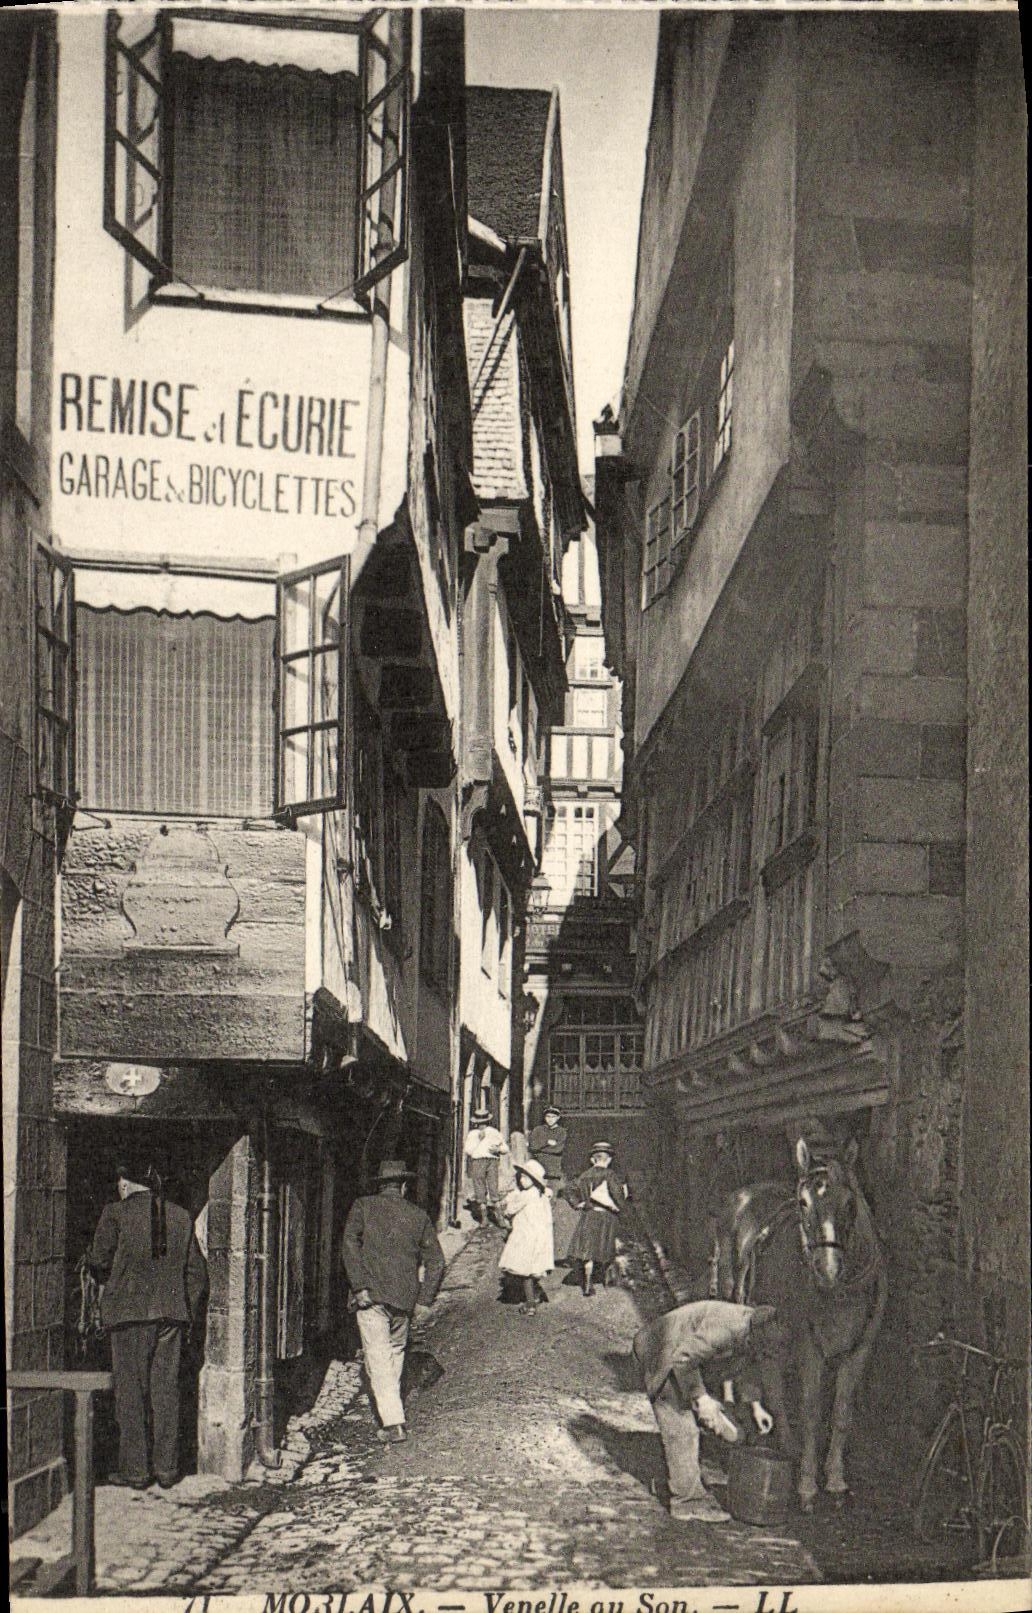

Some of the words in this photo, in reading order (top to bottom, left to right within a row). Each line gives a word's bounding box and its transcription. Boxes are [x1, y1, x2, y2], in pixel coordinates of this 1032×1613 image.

[60, 372, 199, 442] REMISE
[236, 377, 360, 458] ÉCURIE
[59, 451, 162, 502] GARAGE
[189, 463, 356, 518] BICYCLETTES
